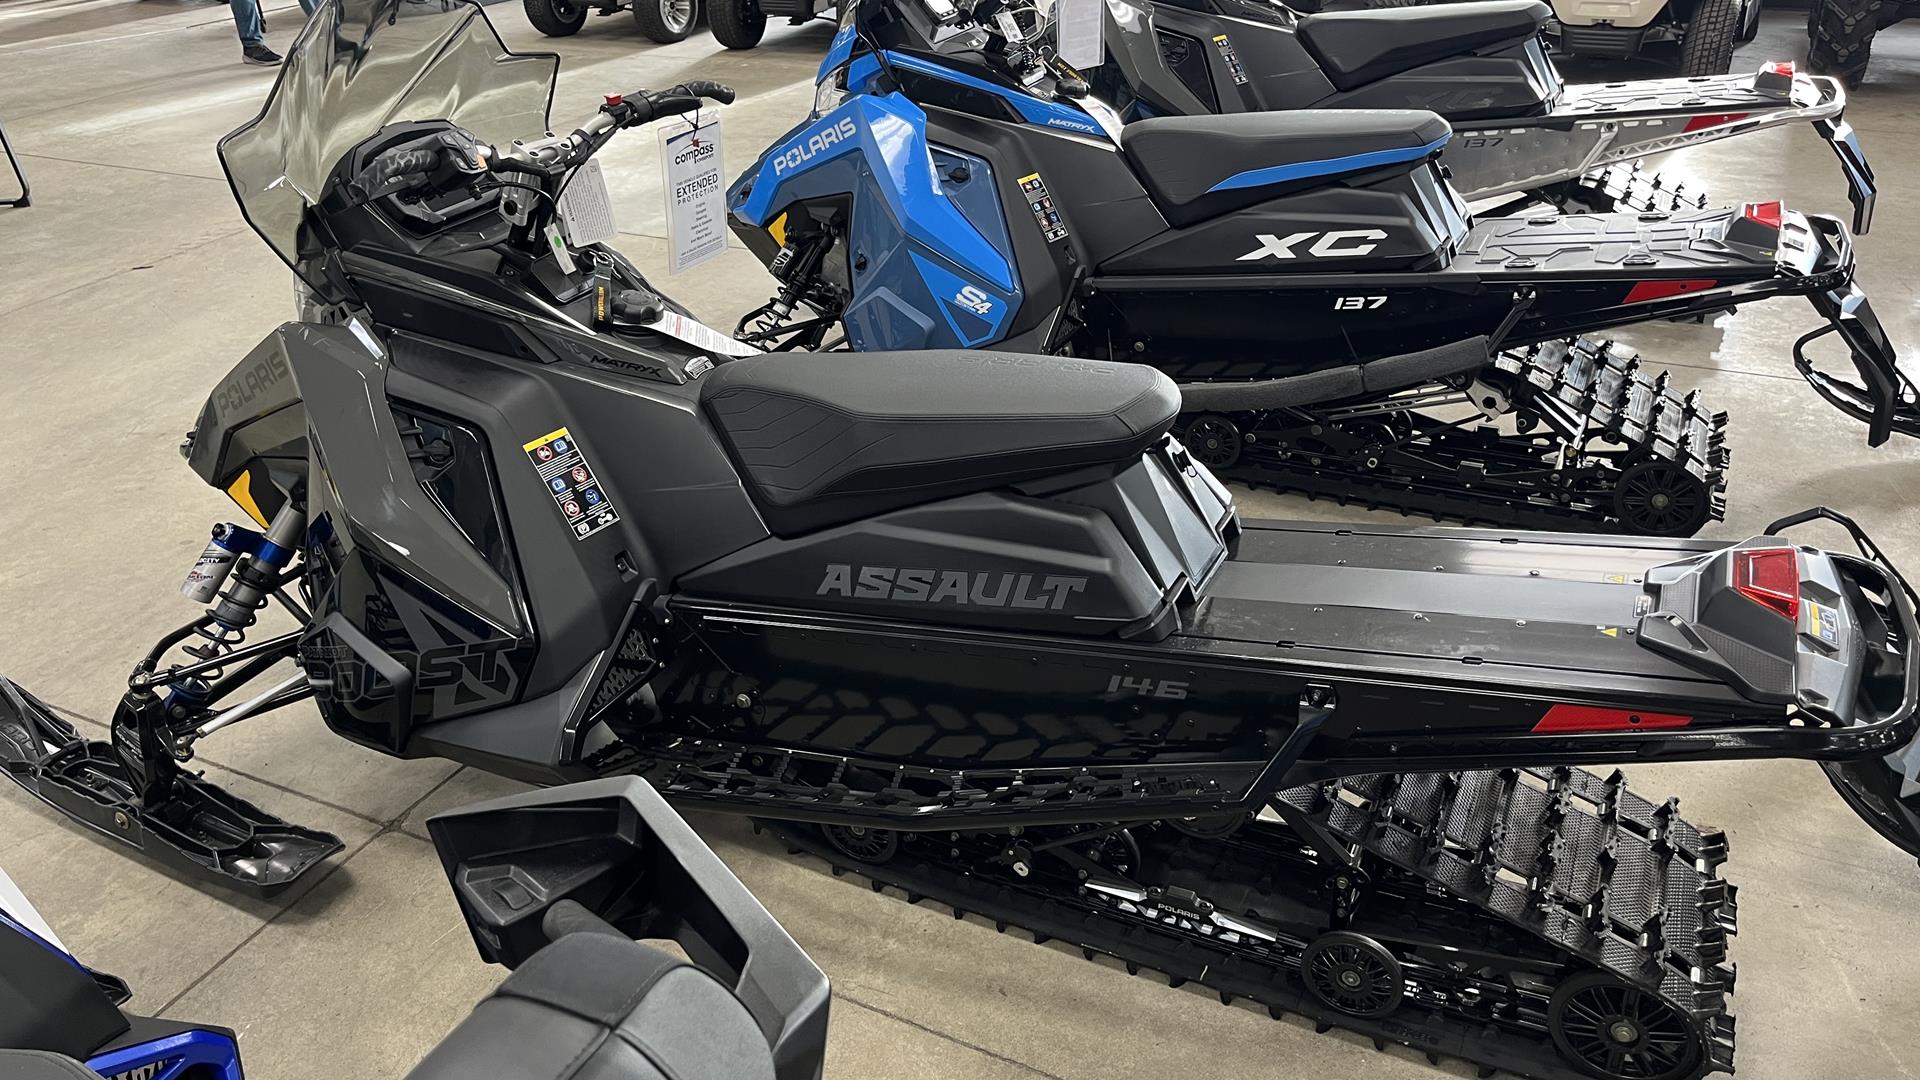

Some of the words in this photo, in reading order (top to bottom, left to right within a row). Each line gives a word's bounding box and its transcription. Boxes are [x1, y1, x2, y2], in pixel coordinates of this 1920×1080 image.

[1047, 118, 1095, 133] MATRYX
[675, 143, 714, 165] compass
[773, 117, 857, 176] POLARIS
[1463, 137, 1504, 148] 137
[676, 173, 718, 198] EXTENDED
[677, 184, 719, 206] PROTECTION
[1235, 229, 1389, 261] XC
[1334, 296, 1388, 310] 137
[590, 355, 662, 378] MATRYX
[217, 351, 289, 418] POLARIS
[816, 563, 1088, 610] ASSAULT
[1106, 674, 1190, 700] 146
[1158, 903, 1200, 920] POLARIS
